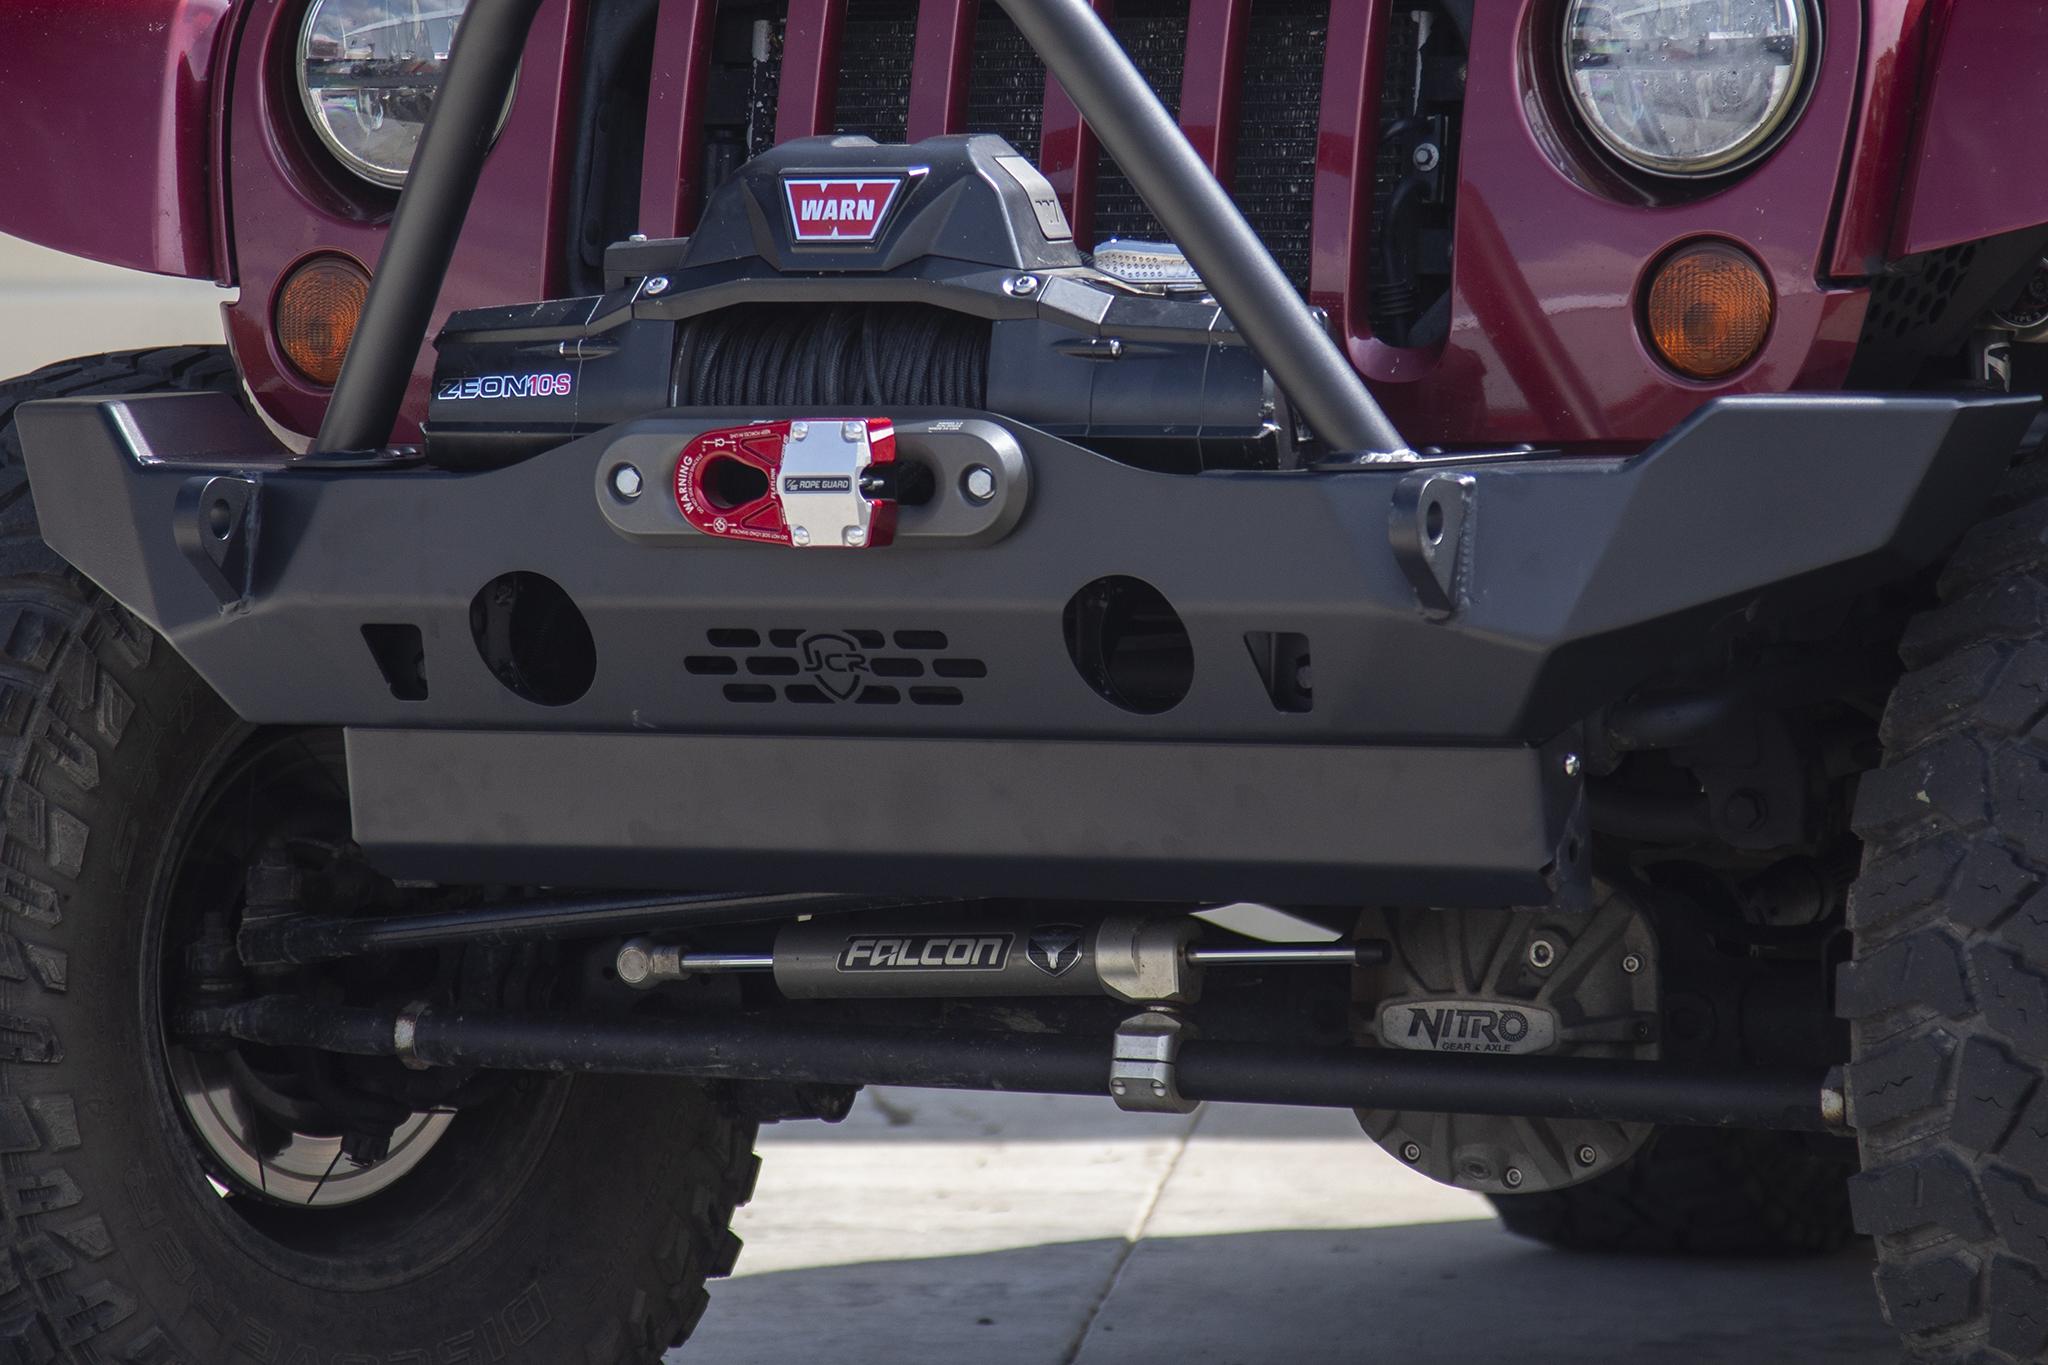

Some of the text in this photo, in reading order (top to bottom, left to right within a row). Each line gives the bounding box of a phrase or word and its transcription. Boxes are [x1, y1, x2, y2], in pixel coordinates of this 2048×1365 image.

[801, 199, 875, 221] WARN
[678, 455, 693, 515] WARNING
[799, 480, 821, 489] ROPE
[822, 480, 849, 489] GUARD
[804, 650, 870, 673] JCR
[845, 938, 1004, 967] FALCON
[1408, 1008, 1529, 1049] NITRO
[1442, 1042, 1471, 1051] GEAR
[1484, 1043, 1512, 1053] AXLE
